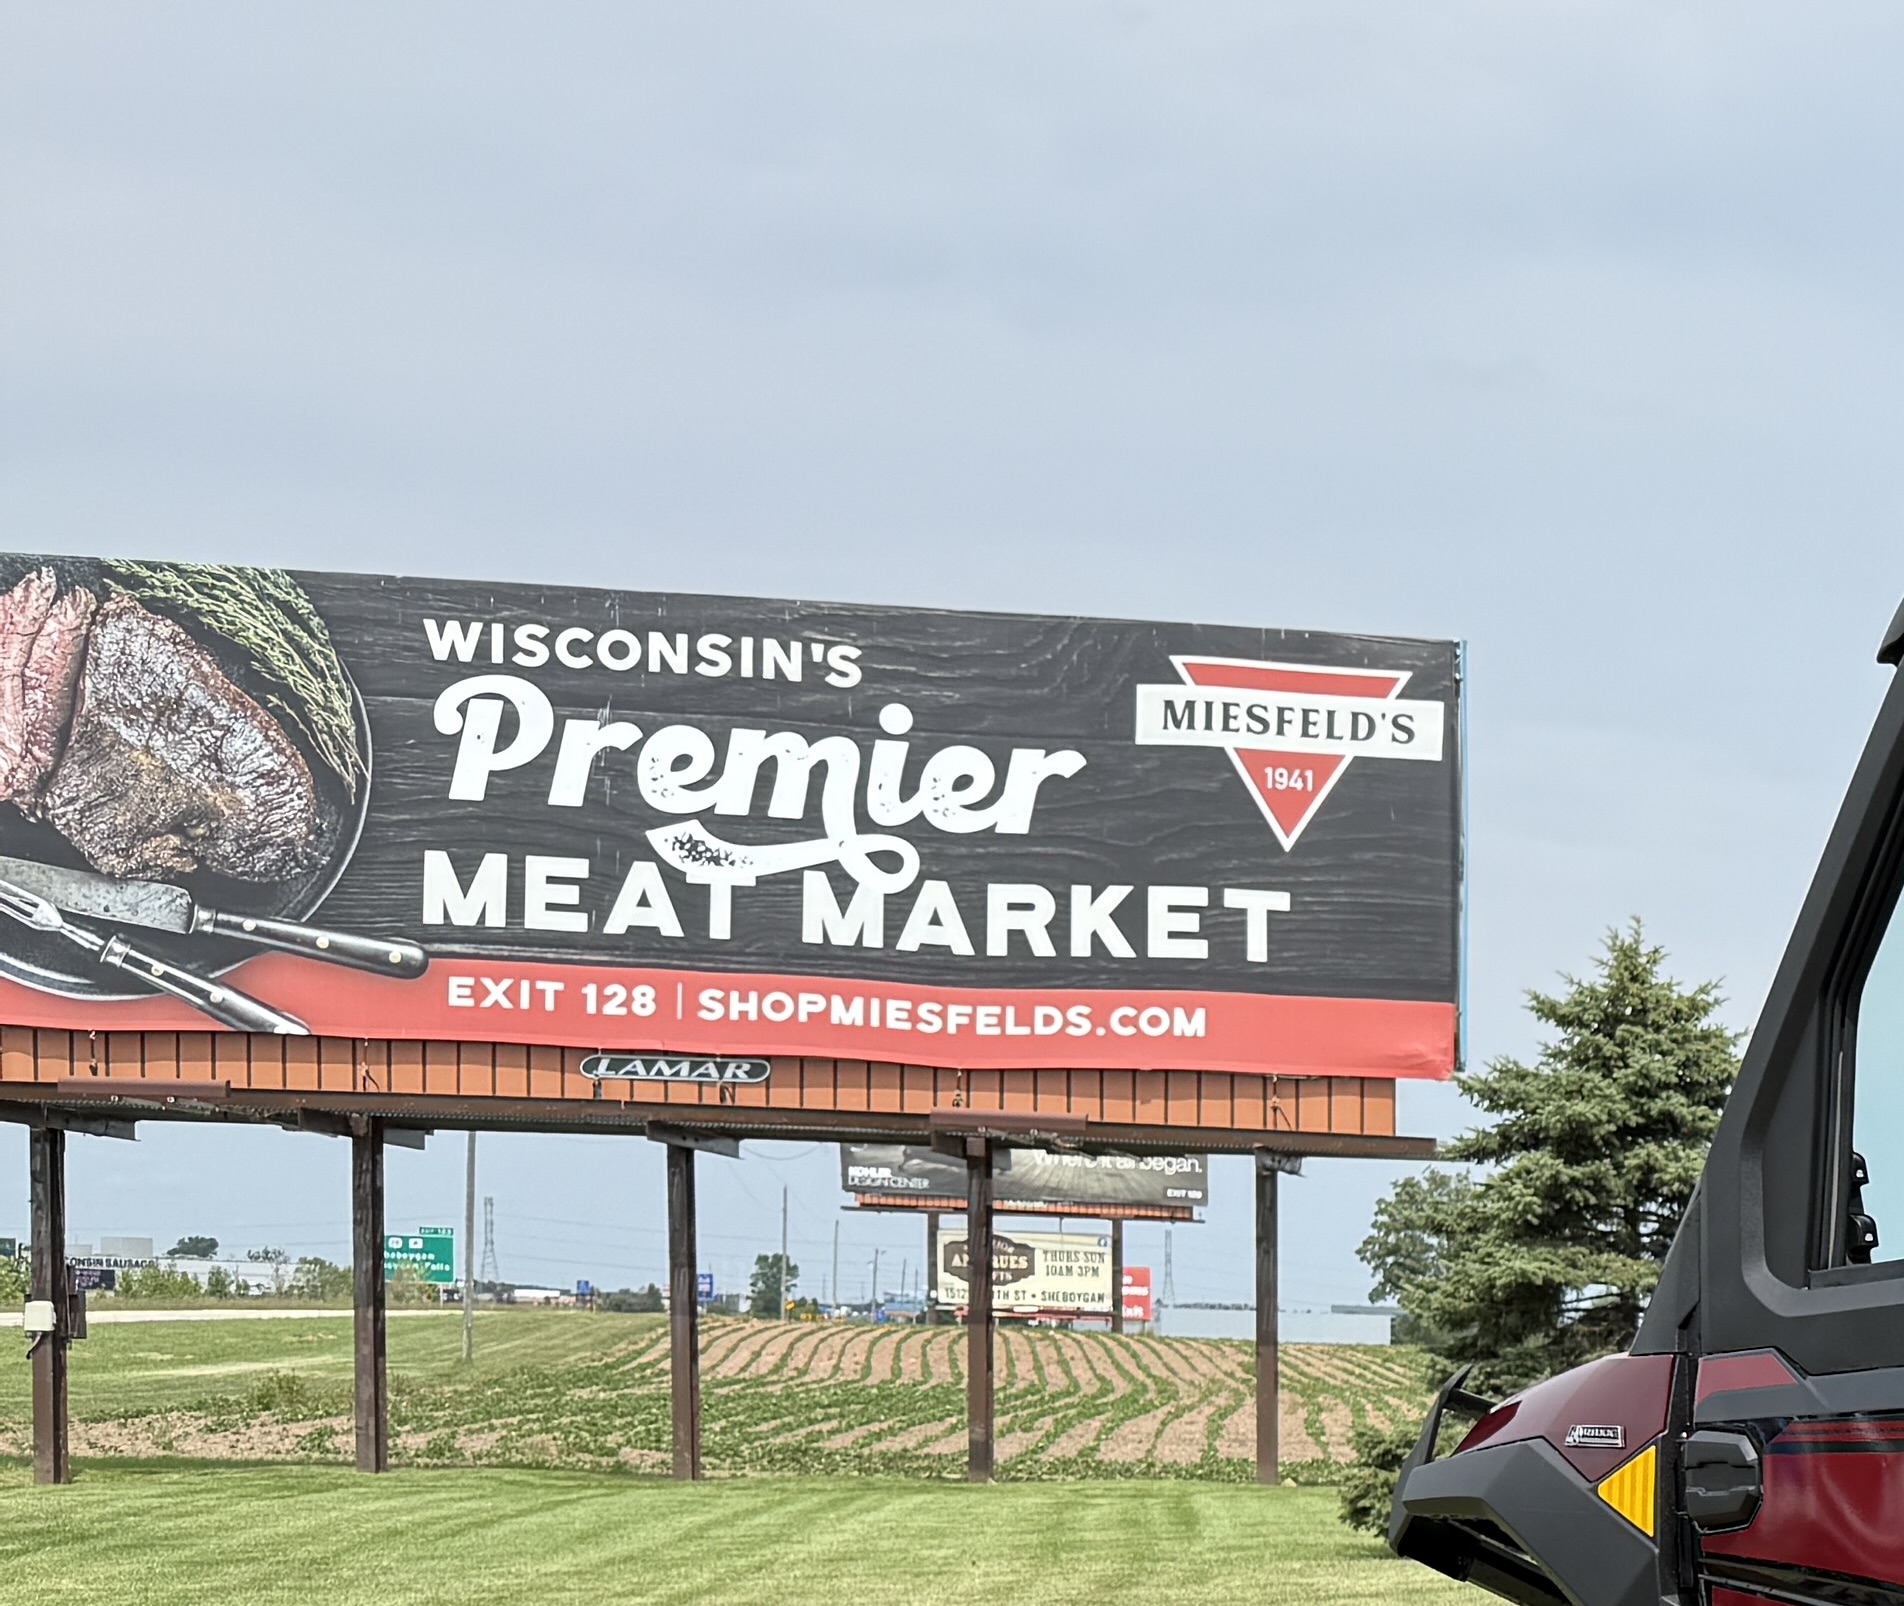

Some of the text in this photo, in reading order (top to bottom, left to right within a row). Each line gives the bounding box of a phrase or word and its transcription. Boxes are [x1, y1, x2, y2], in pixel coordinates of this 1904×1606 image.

[422, 618, 863, 688] WISCONSIN'S
[1162, 699, 1416, 745] MIESFELD'S
[433, 674, 1088, 894] Premier
[1264, 766, 1314, 792] 1941
[422, 849, 733, 940] MEAT
[801, 869, 1291, 963] MARKET
[447, 975, 1207, 1038] EXIT 128 SHOPMIESFELDS.COM
[592, 1058, 752, 1080] LAMAR
